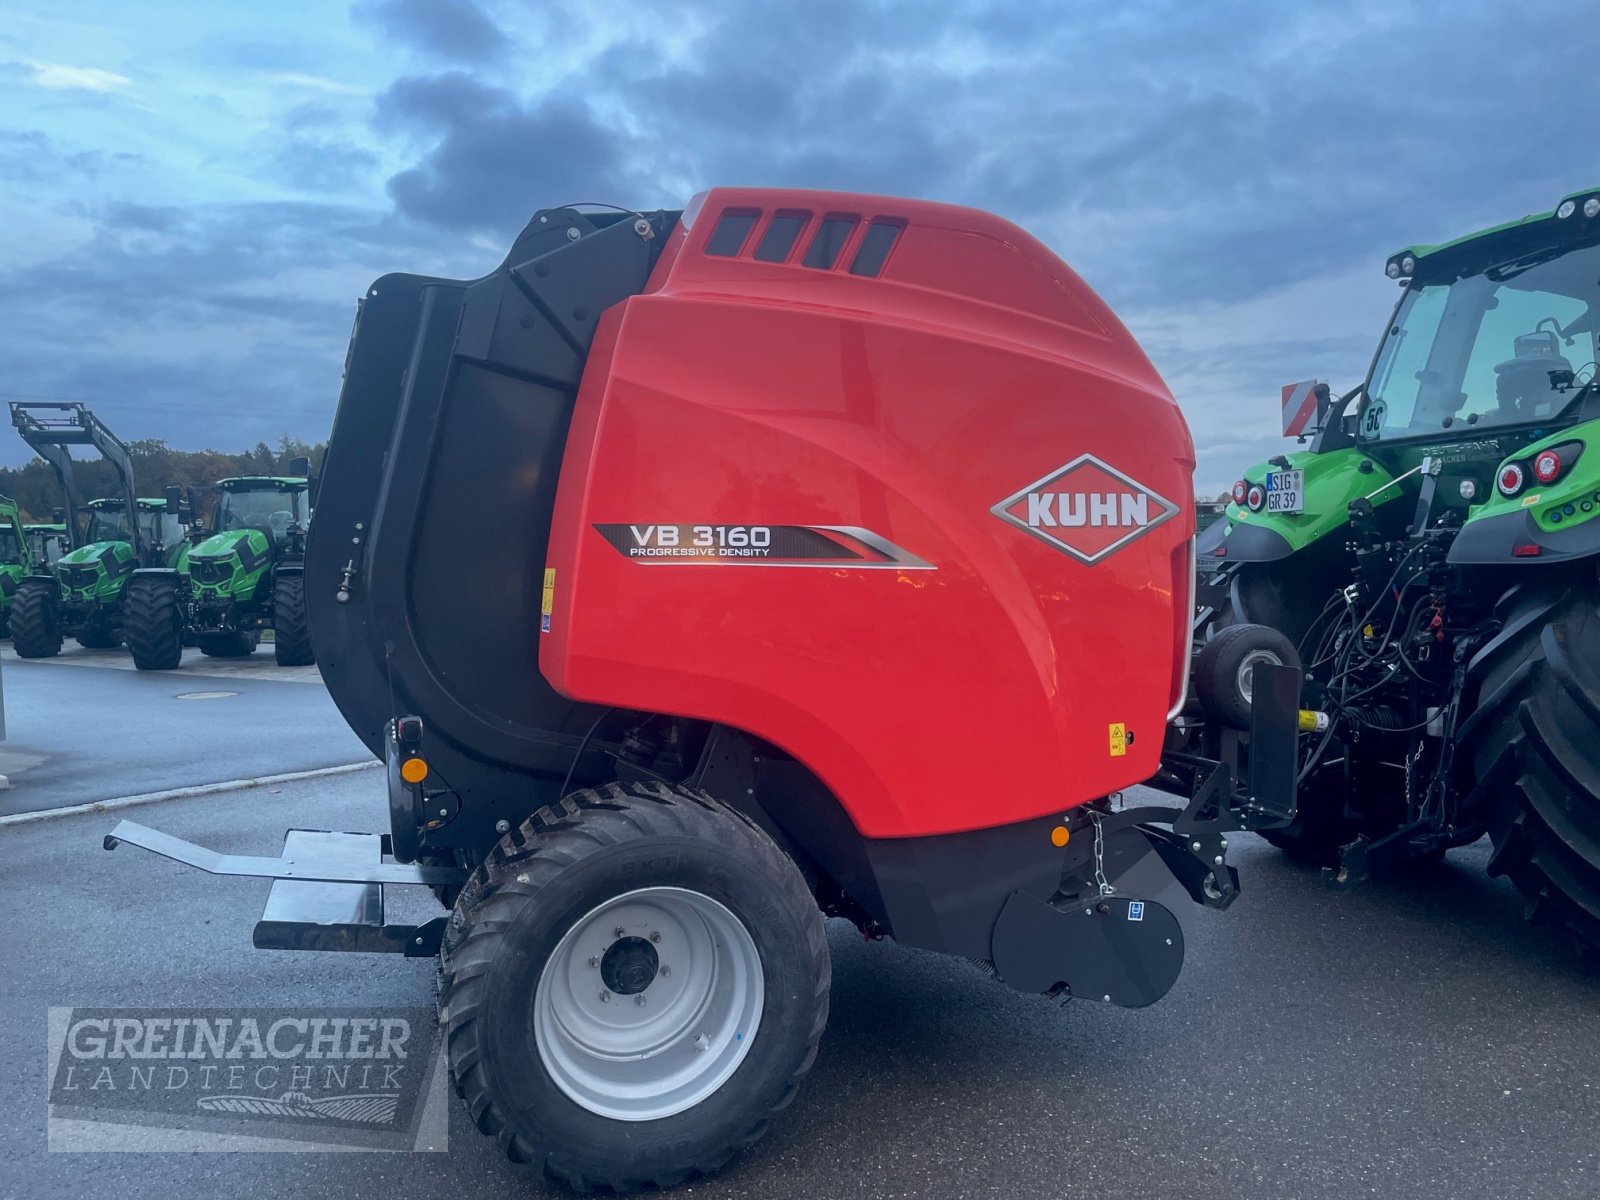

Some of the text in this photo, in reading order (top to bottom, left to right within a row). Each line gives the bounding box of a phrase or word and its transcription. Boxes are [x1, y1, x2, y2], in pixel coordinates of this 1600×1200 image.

[1273, 474, 1291, 491] SIG
[1027, 493, 1148, 527] KUHN
[1268, 491, 1296, 510] GR 39
[629, 525, 771, 547] VB 3160
[630, 548, 770, 557] PROGRESSIVE DENSITY
